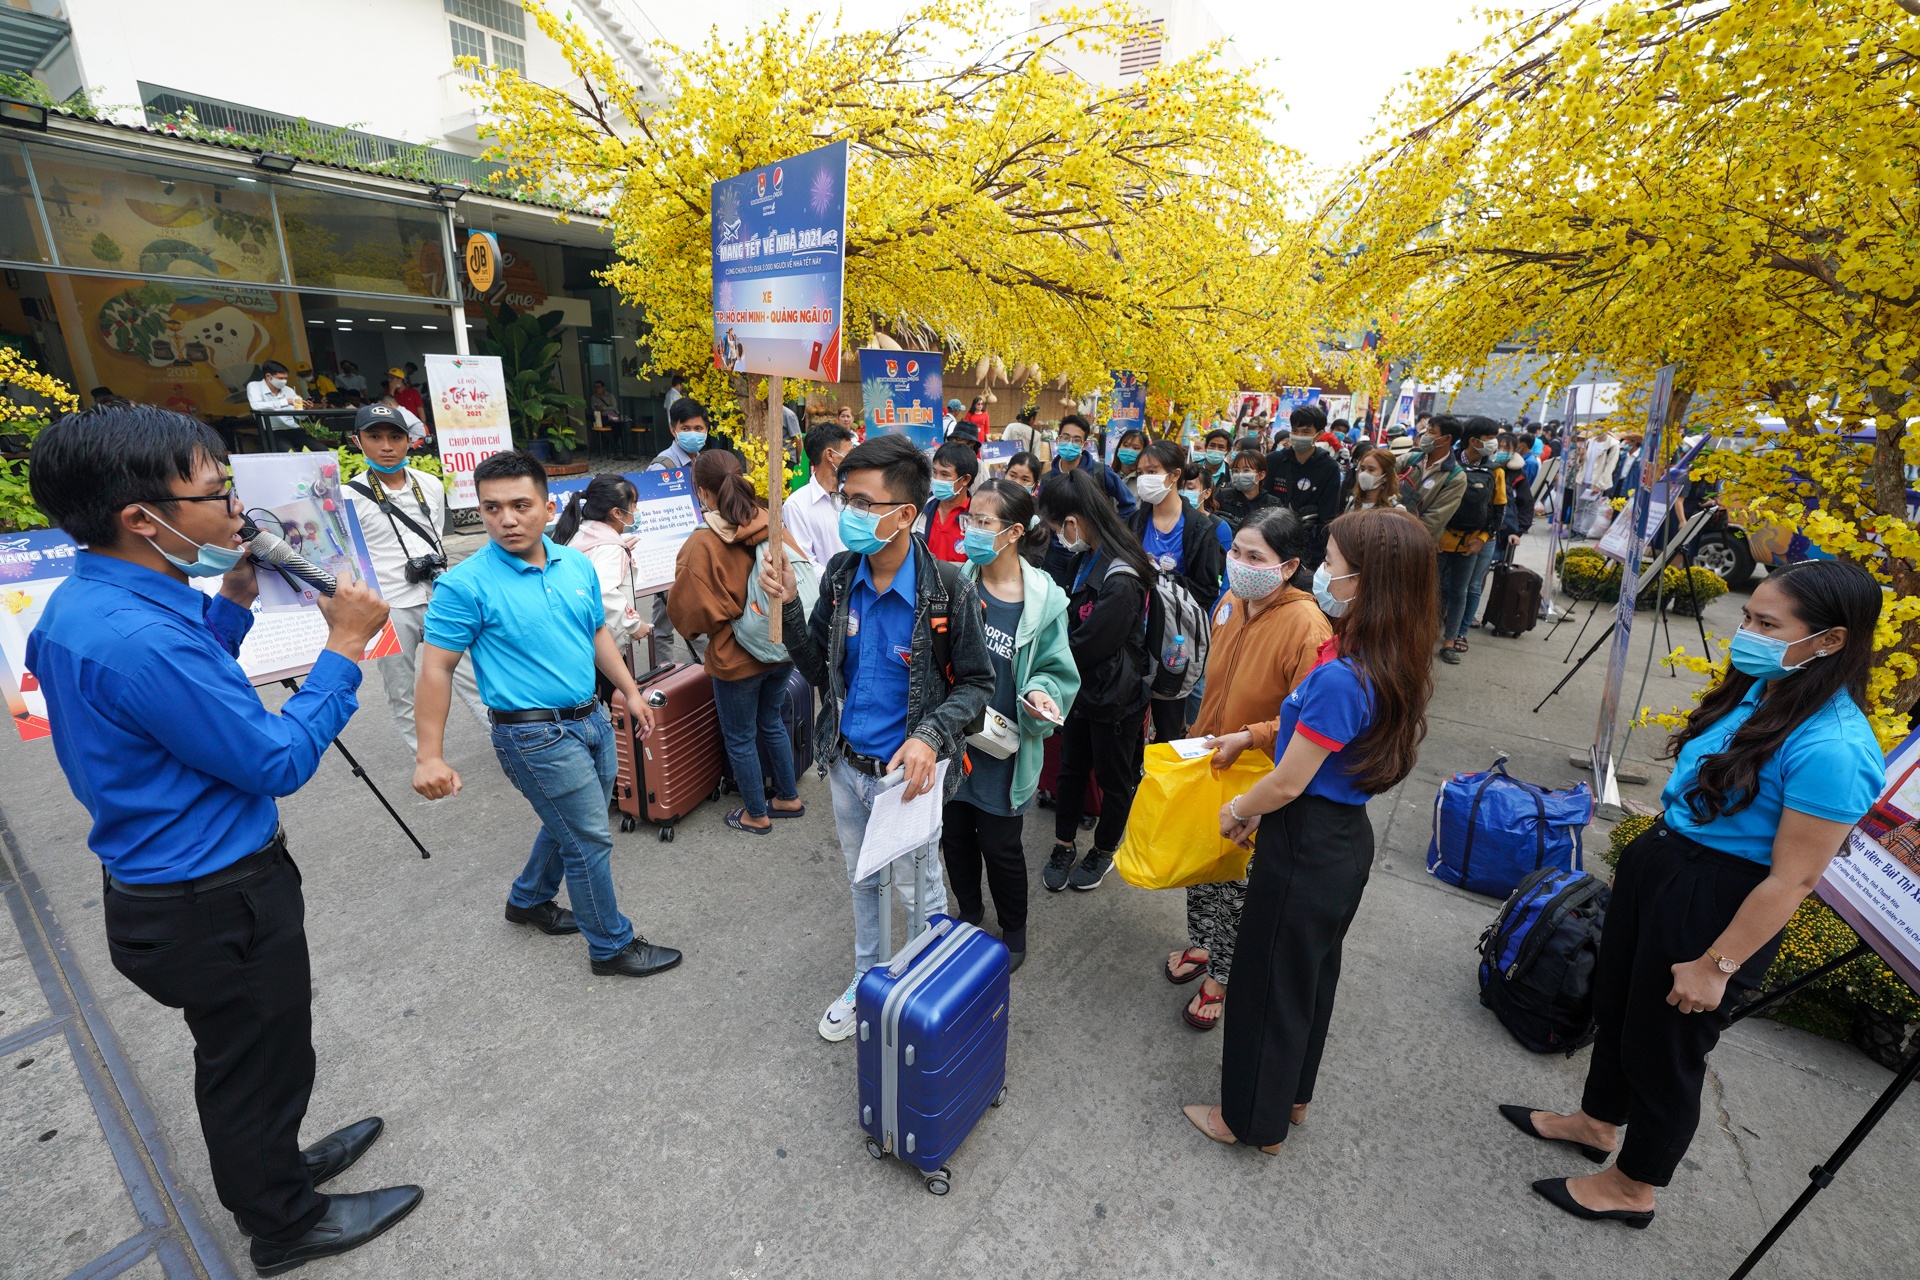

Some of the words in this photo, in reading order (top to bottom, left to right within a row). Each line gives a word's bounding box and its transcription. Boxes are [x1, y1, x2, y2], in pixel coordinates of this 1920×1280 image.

[720, 243, 743, 262] MANG
[745, 233, 761, 258] TẾT
[762, 229, 778, 255] VỀ
[776, 228, 796, 254] NHÀ
[798, 228, 822, 250] 2021
[224, 295, 263, 306] CADA
[762, 291, 772, 303] XE
[716, 310, 725, 323] TP.
[726, 306, 735, 323] HỒ
[736, 309, 748, 323] CHÍ
[748, 311, 766, 323] MINH
[770, 306, 798, 324] QUẢNG
[800, 306, 820, 324] NGÃI
[822, 309, 832, 324] 01
[166, 368, 198, 378] 2019
[874, 399, 894, 424] LỄ
[897, 399, 933, 423] TIỄN
[449, 437, 470, 448] CHỤP
[42, 544, 76, 559] TẾT
[1848, 834, 1865, 852] Sinh
[1864, 849, 1883, 867] viên:
[1881, 863, 1900, 880] Bùi
[1896, 875, 1915, 893] Thị
